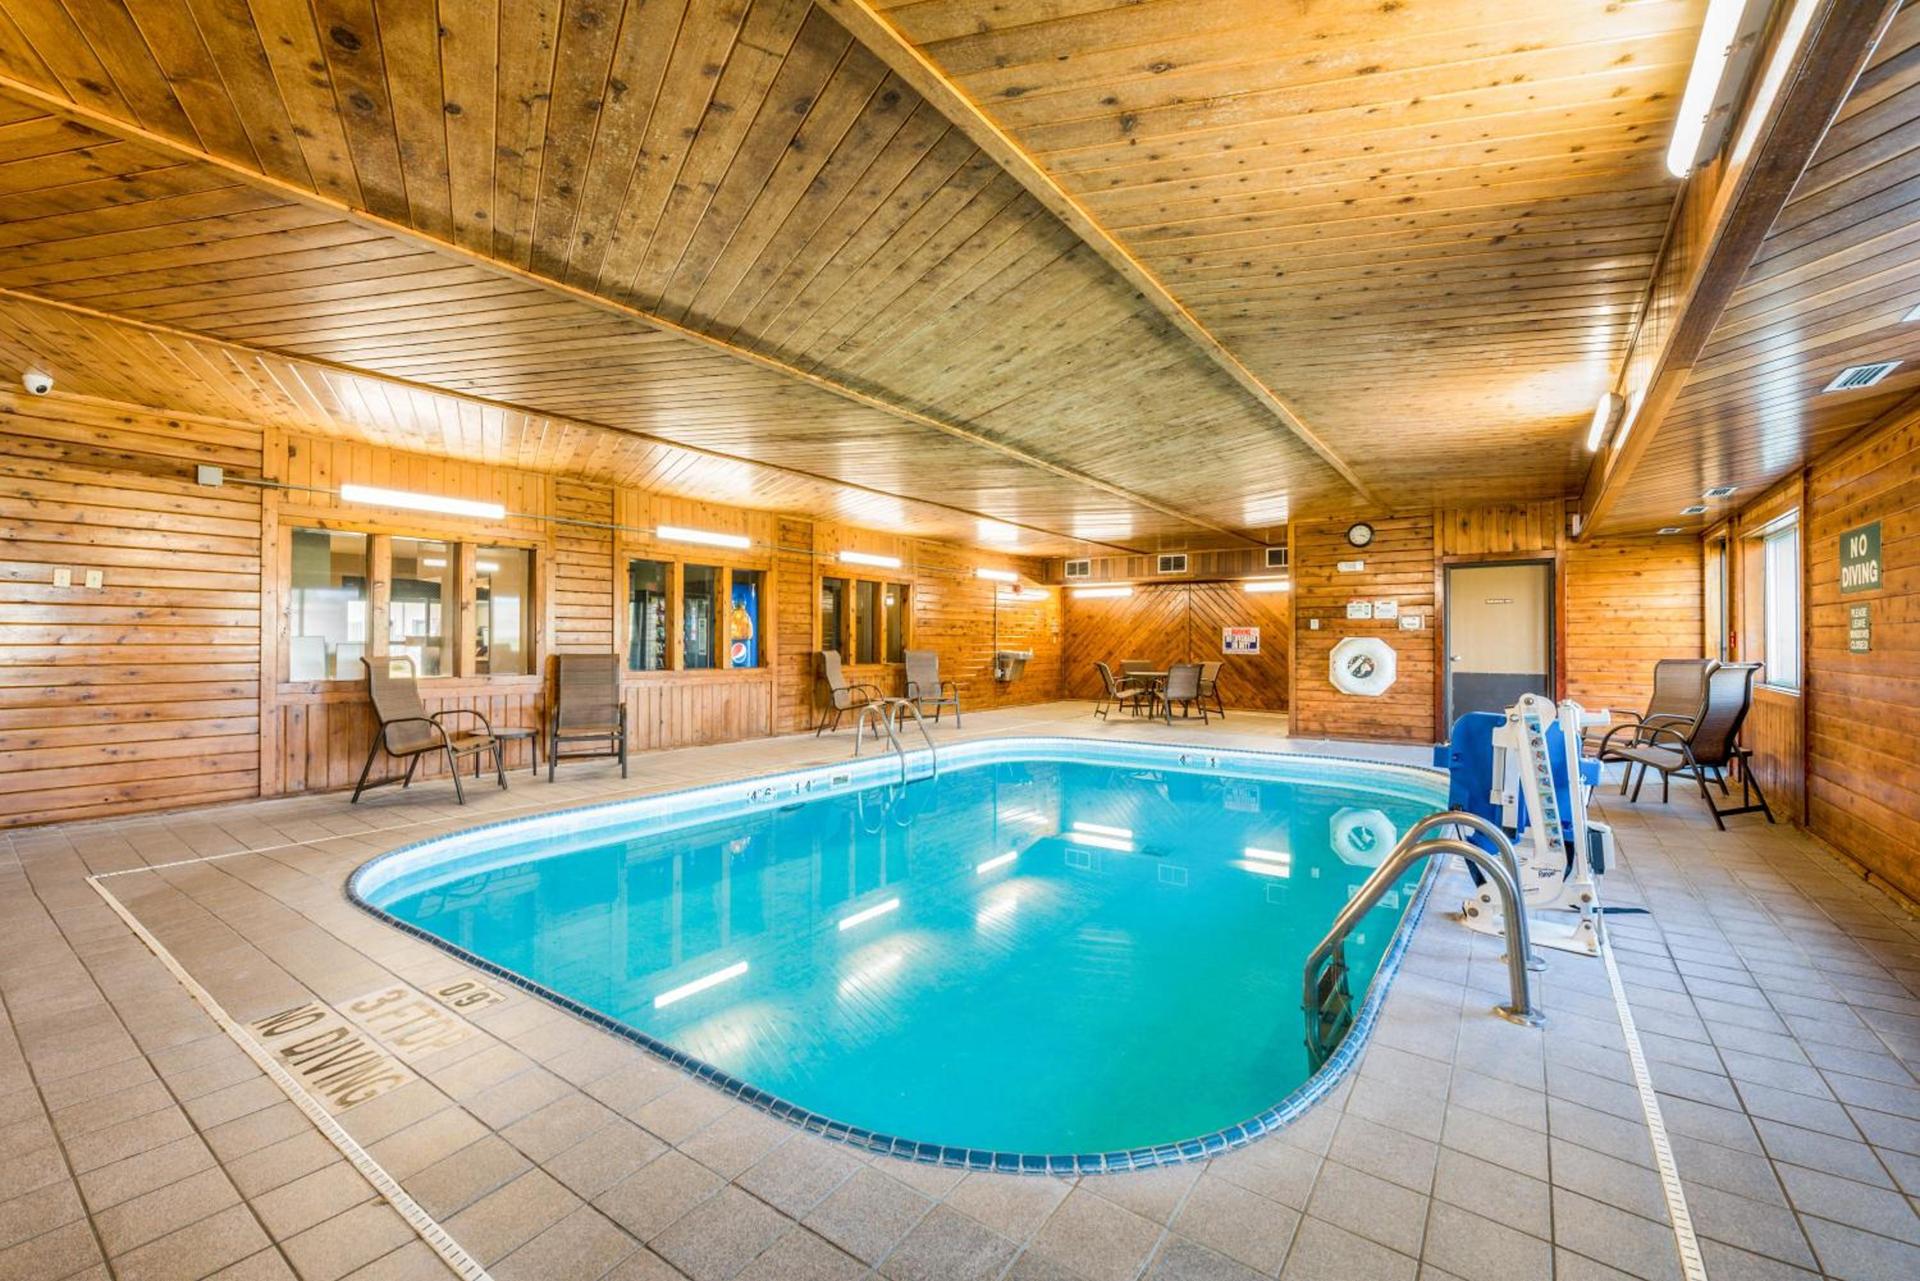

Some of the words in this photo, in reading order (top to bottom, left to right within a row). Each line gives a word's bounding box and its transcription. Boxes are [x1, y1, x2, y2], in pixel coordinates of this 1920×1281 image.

[1850, 534, 1867, 558] NO
[1842, 560, 1878, 588] DIVING
[251, 1003, 326, 1037] NO
[280, 1026, 404, 1109] DIVING
